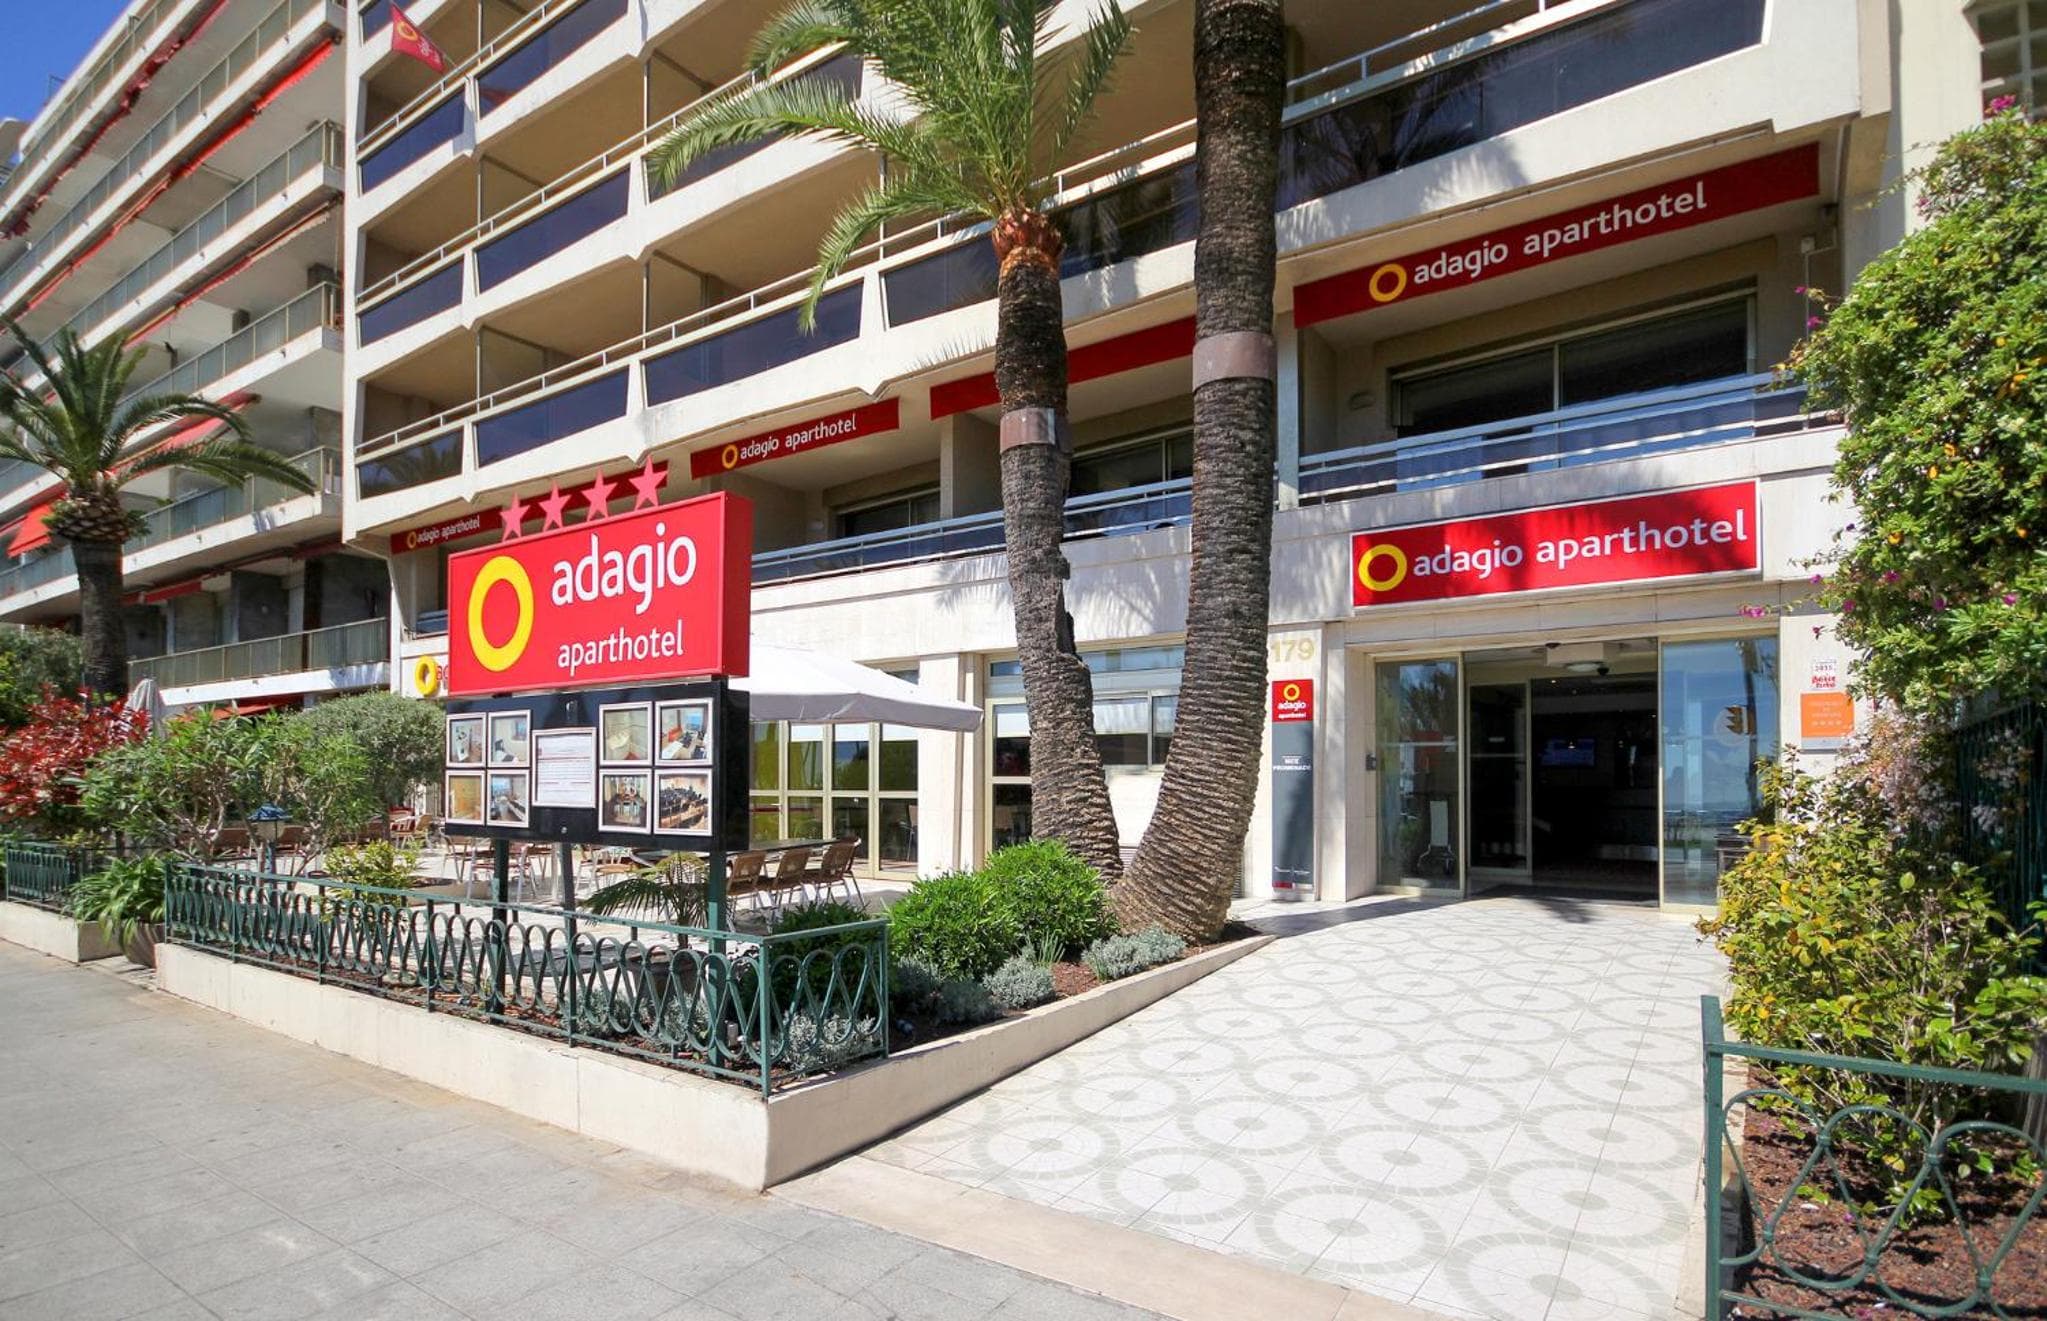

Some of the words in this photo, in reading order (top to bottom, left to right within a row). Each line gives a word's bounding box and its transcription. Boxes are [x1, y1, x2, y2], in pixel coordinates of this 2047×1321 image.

[1413, 240, 1509, 279] adagio
[1522, 181, 1708, 257] aparthotel
[739, 436, 780, 458] adagio
[784, 413, 857, 450] aparthotel
[417, 527, 440, 544] adagio
[441, 514, 480, 540] aparthotel
[1412, 540, 1523, 579] adagio
[1535, 508, 1748, 569] aparthotel
[551, 521, 697, 616] adagio
[557, 618, 684, 678] aparthotel
[1270, 637, 1315, 662] 179
[1277, 700, 1306, 711] adagio
